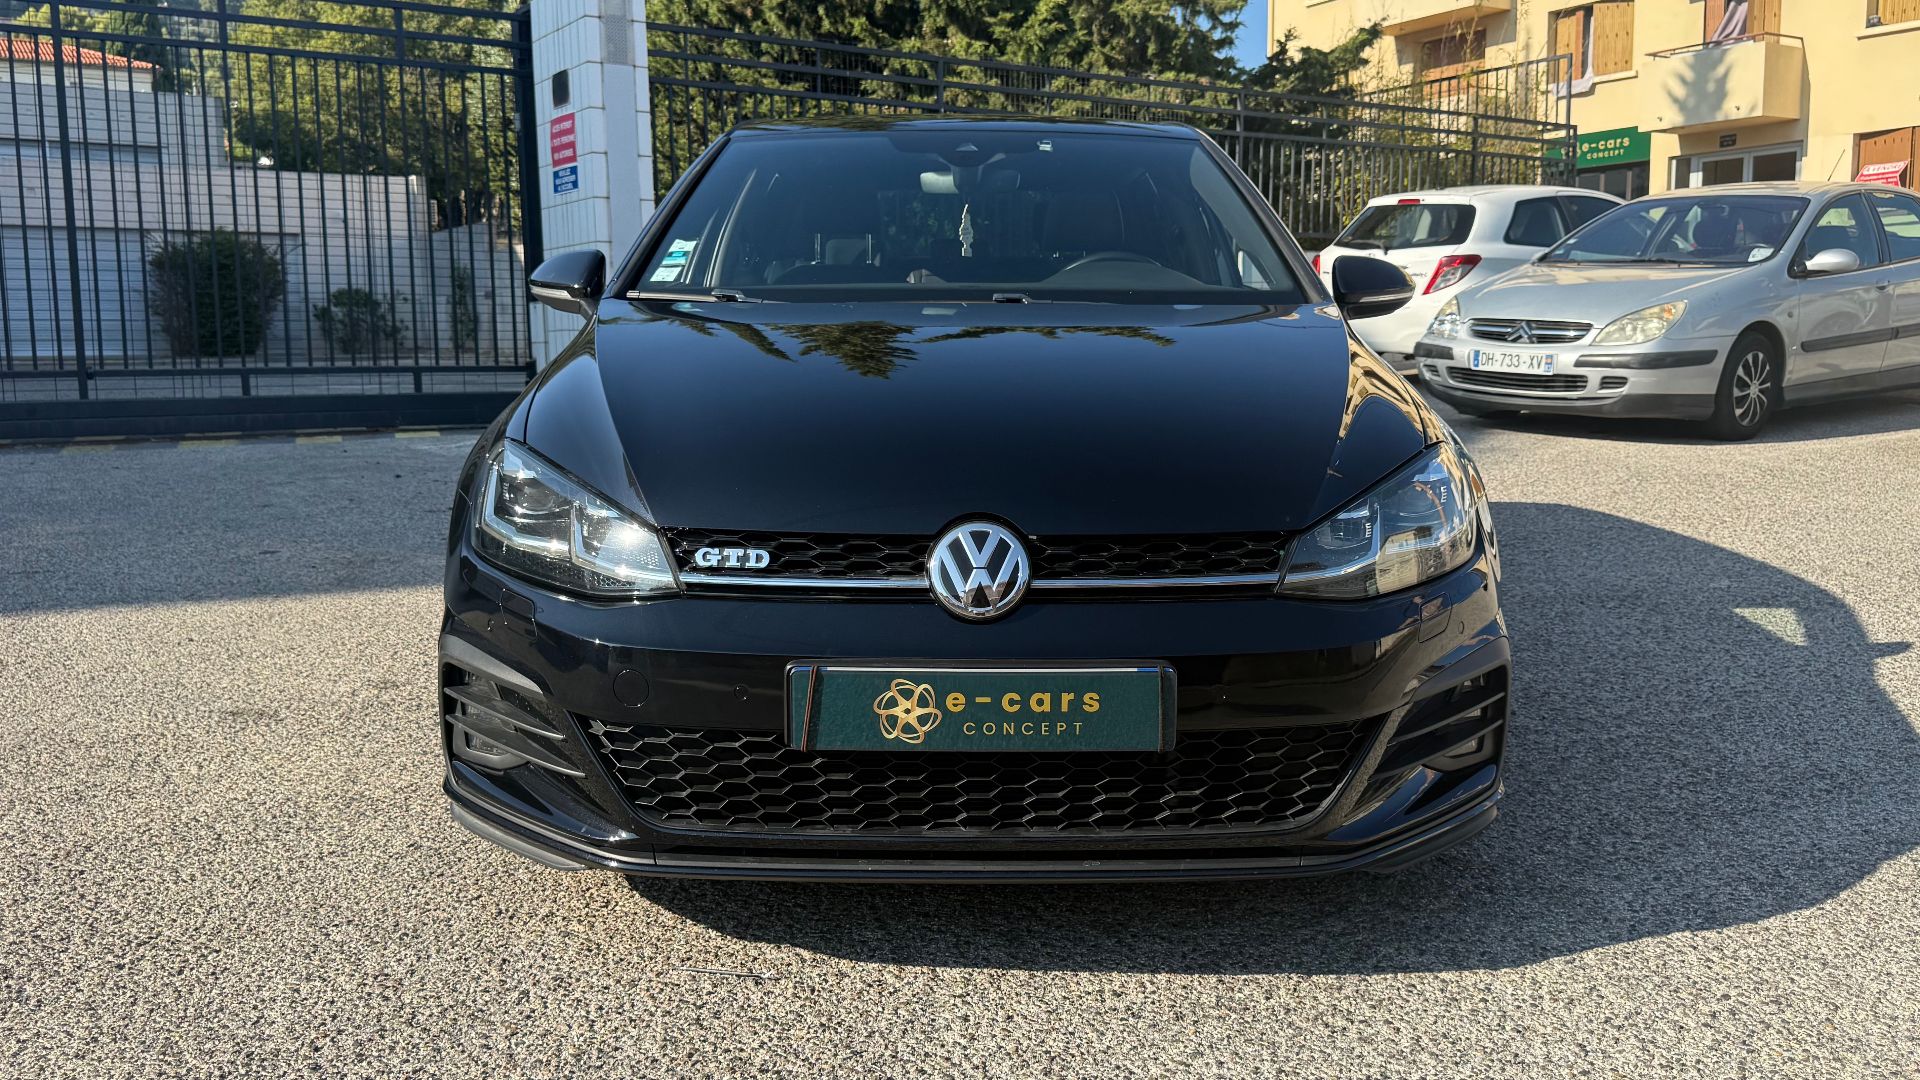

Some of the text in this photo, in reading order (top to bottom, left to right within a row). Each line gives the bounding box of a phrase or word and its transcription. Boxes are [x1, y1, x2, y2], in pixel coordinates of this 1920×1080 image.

[1582, 137, 1630, 151] e-cars
[1587, 149, 1624, 159] CONCEPT
[1481, 352, 1543, 369] DH-733-XV
[694, 547, 770, 569] GTD
[945, 690, 1101, 714] e-cars
[963, 722, 1085, 736] CONCEPT
